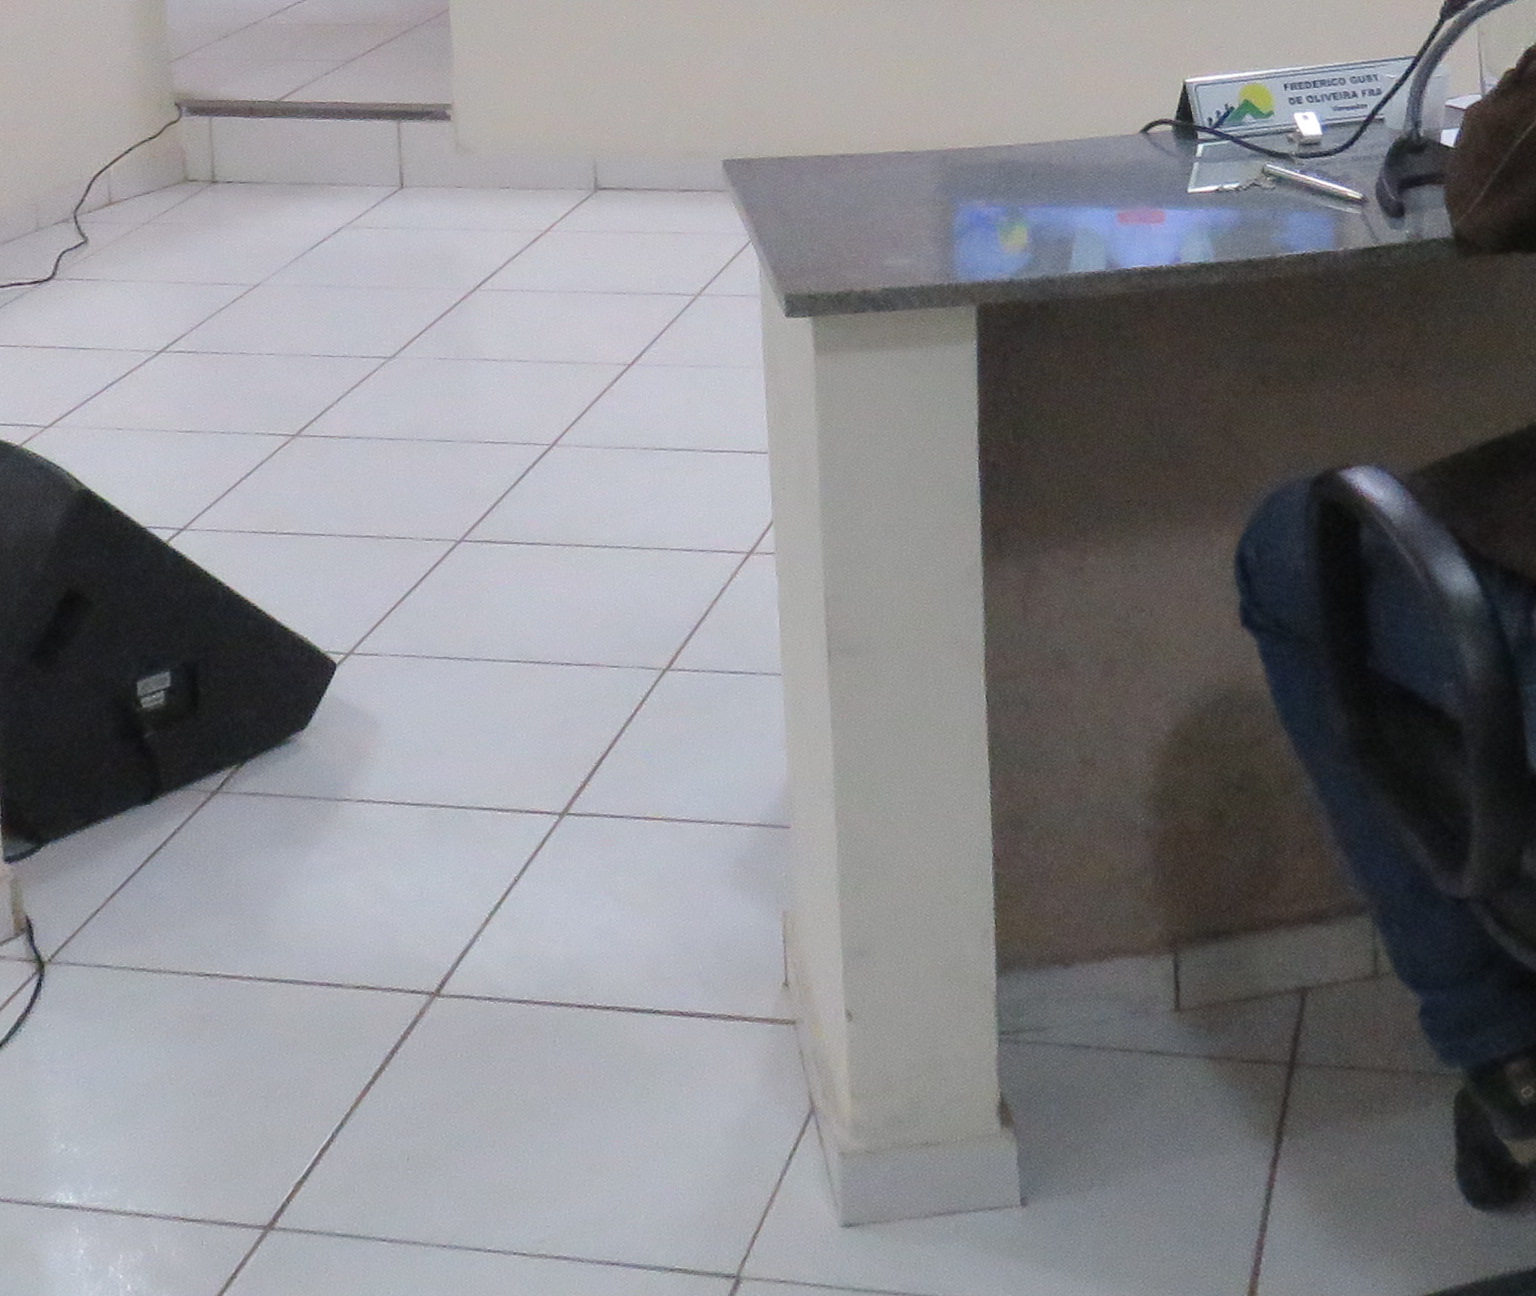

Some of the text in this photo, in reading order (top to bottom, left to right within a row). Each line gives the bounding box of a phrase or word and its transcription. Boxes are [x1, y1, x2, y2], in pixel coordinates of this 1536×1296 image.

[1284, 77, 1346, 91] FREDERICO
[1288, 95, 1303, 105] DE
[1306, 90, 1358, 104] OLIVEIRA
